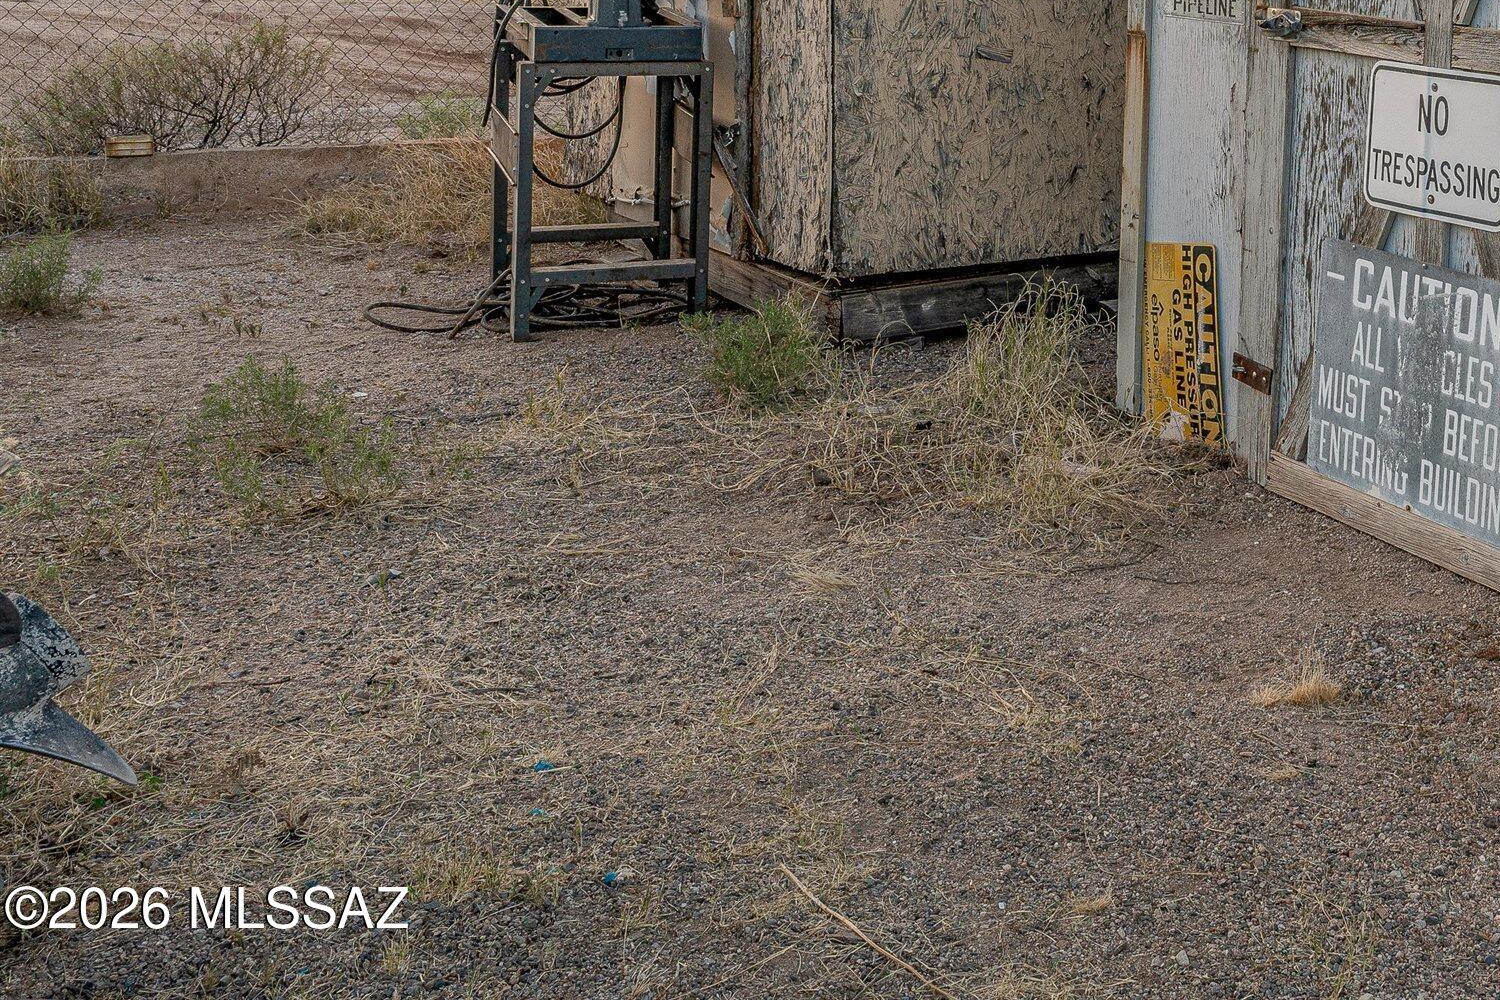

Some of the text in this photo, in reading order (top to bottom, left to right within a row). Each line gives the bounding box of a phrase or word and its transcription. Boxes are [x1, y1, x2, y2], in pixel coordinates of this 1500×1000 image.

[1418, 94, 1449, 136] NO
[1372, 148, 1500, 204] TRESPASSING
[1172, 289, 1187, 408] GAS LINE
[1182, 245, 1200, 437] HIGH PRESSUR
[1351, 321, 1384, 373] ALL
[1318, 364, 1371, 422] MUST
[1320, 420, 1409, 495] ENTERING
